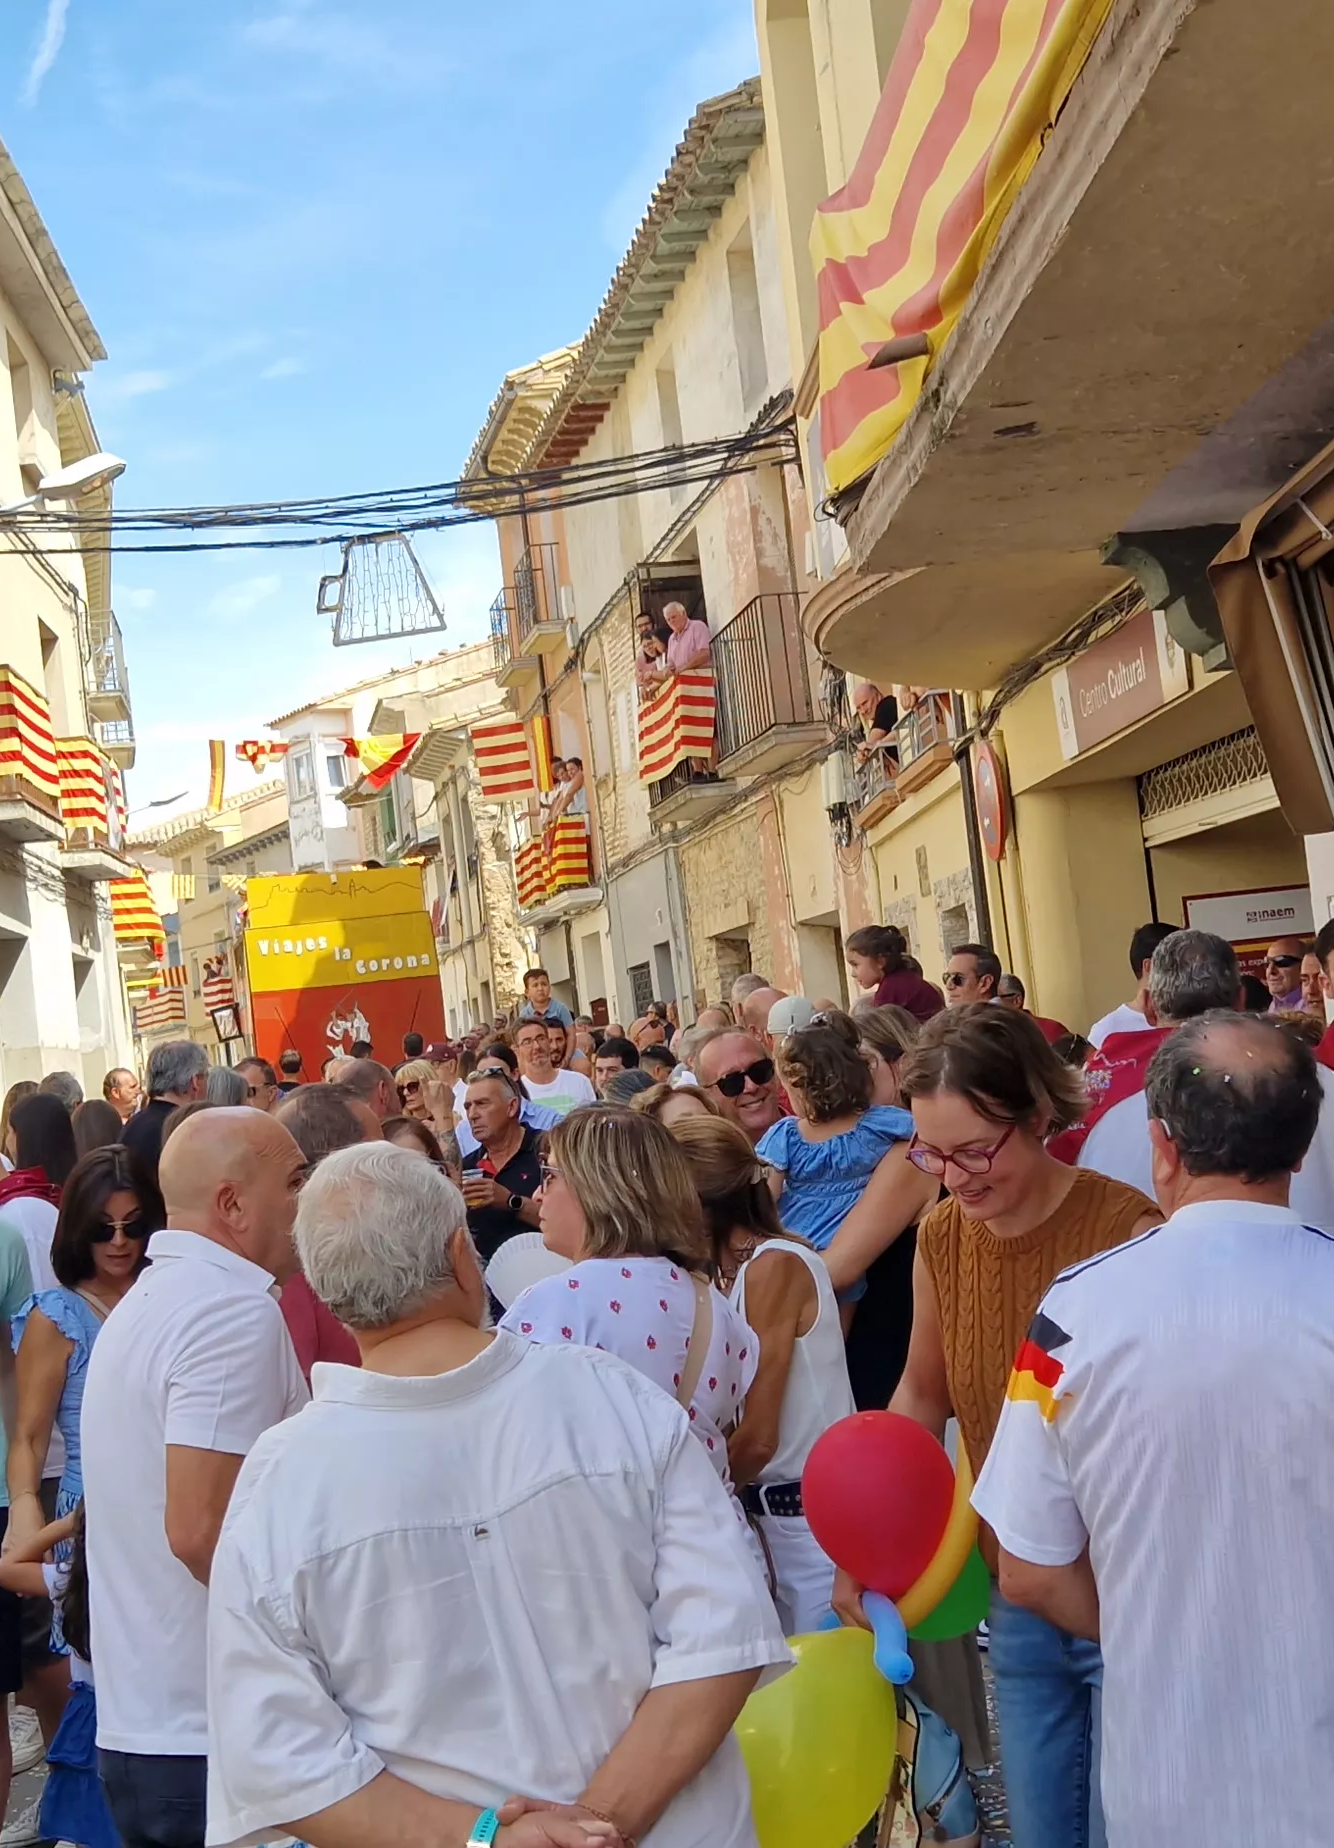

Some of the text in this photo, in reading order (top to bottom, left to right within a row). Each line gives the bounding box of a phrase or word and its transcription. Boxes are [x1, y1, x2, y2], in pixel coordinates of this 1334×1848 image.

[1079, 646, 1147, 718] Centro Cultural
[1258, 907, 1295, 919] inaem
[257, 936, 430, 975] Viajes la Corona
